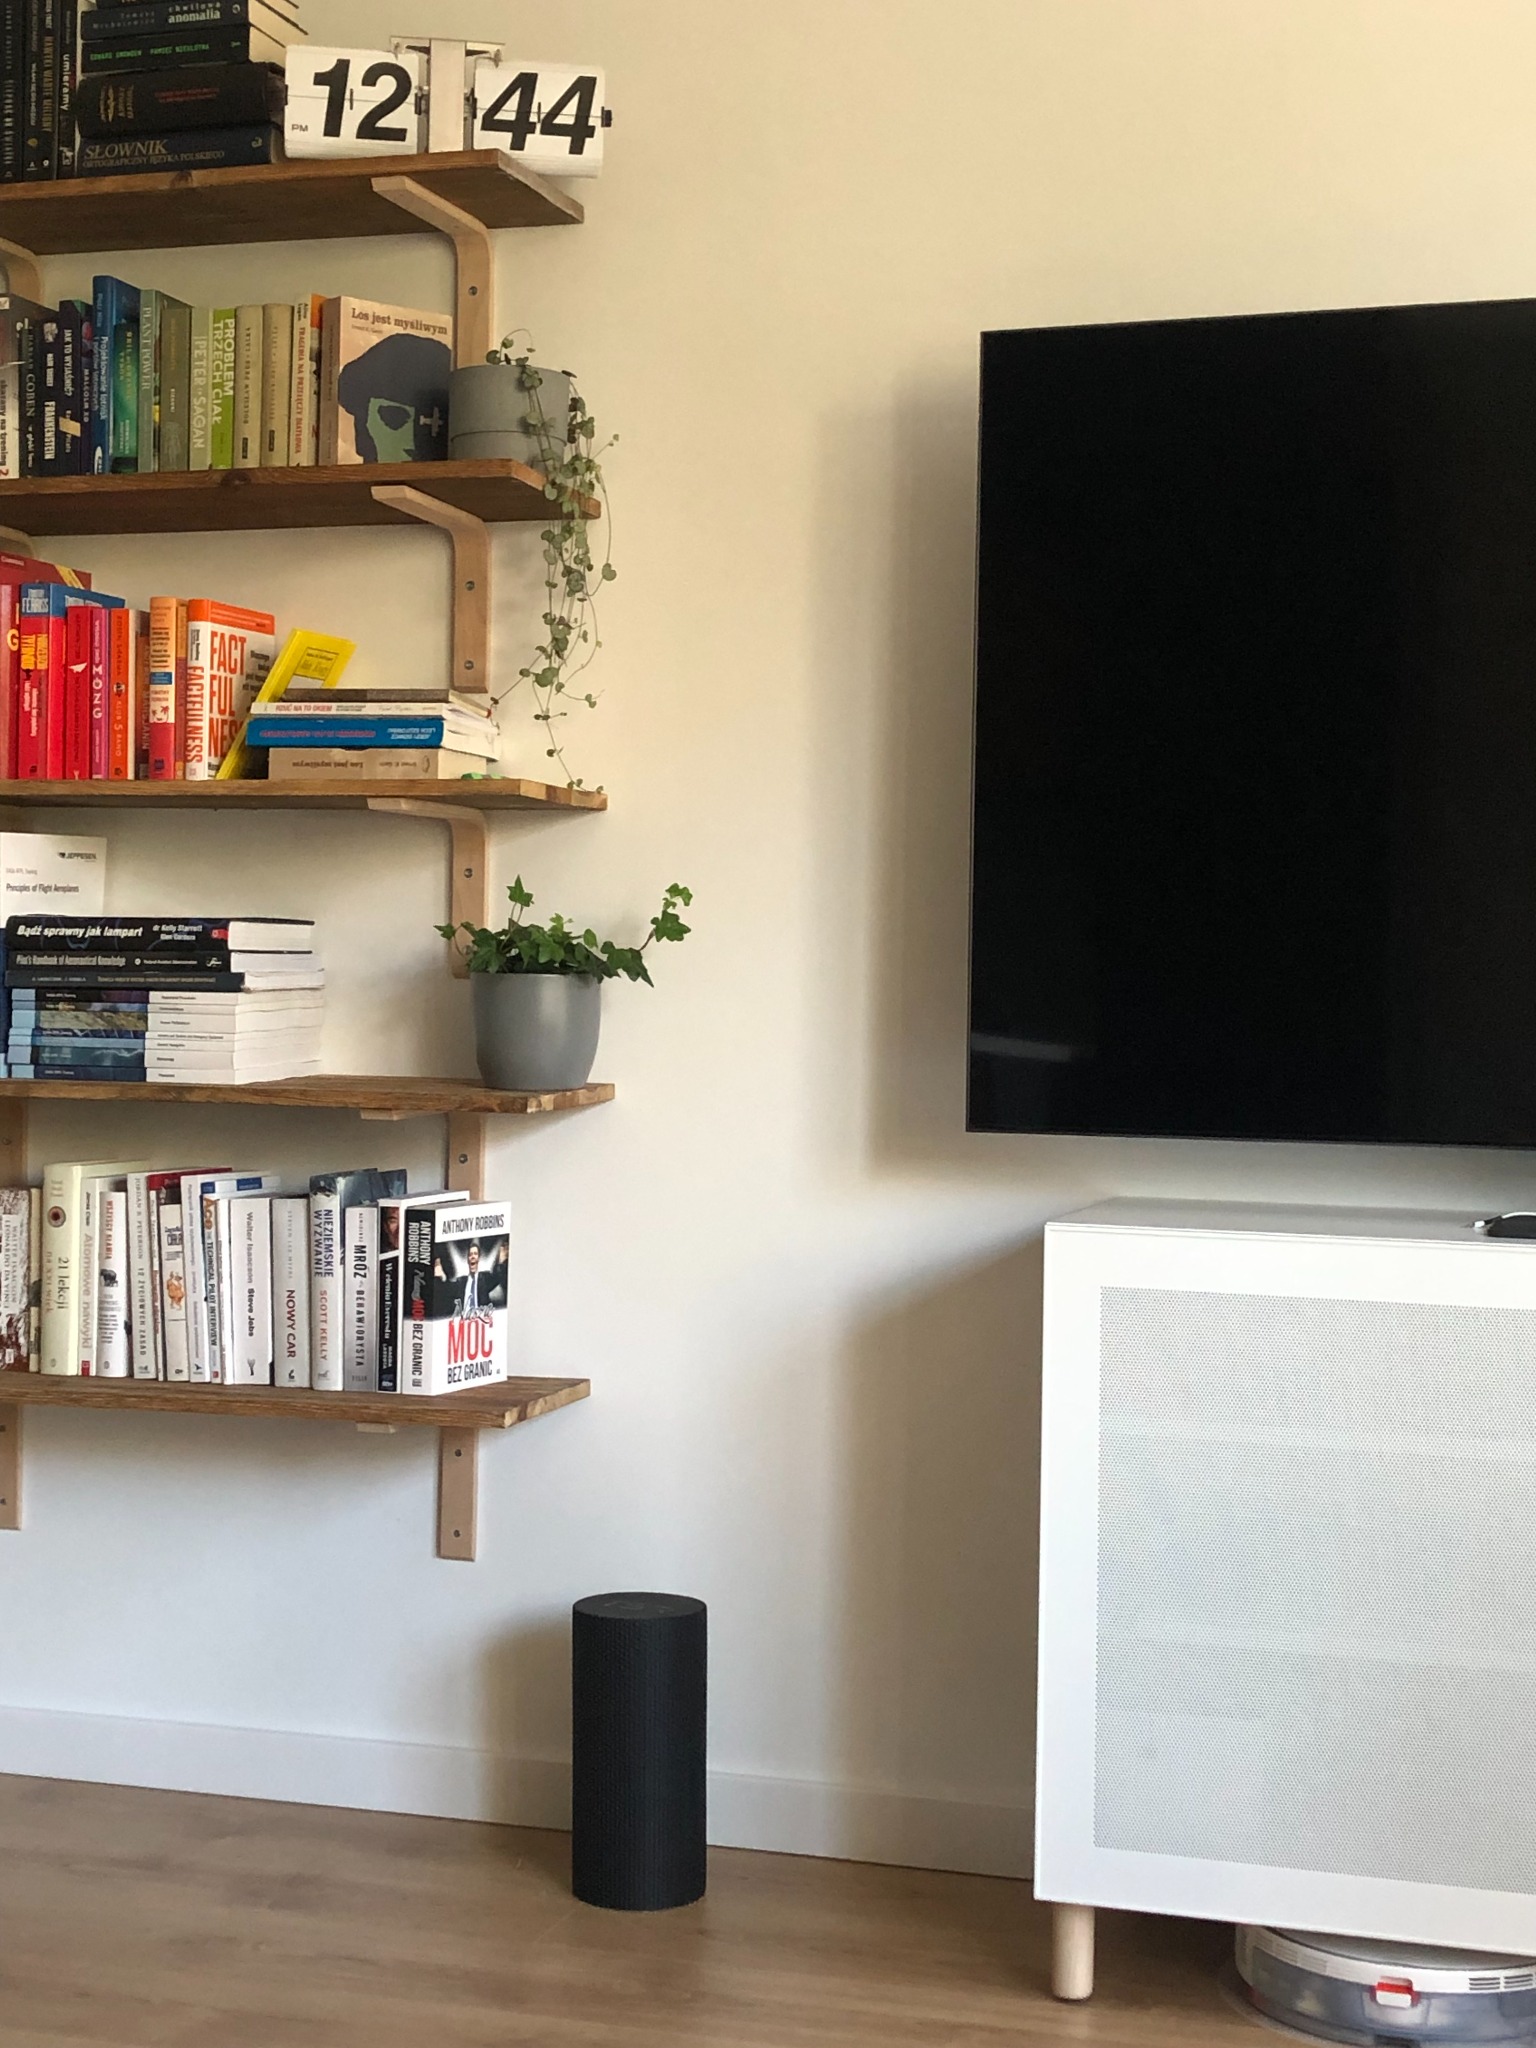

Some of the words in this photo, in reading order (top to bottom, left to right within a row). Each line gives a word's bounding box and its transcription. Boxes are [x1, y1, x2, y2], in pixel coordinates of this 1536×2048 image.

[168, 9, 221, 23] anomalia
[60, 54, 72, 111] umieramy
[313, 58, 412, 142] 12
[480, 72, 597, 155] 44
[291, 124, 309, 133] PM
[84, 139, 169, 159] SŁOWNIK
[180, 151, 225, 162] POLSKIEGO
[142, 307, 152, 345] PLANT
[352, 308, 369, 321] Los
[371, 312, 391, 326] jest
[63, 343, 72, 353] TO
[64, 329, 72, 342] JAK
[212, 320, 224, 382] TRZECH
[297, 327, 306, 362] TRAGEDIA
[99, 336, 109, 392] Projektowanie
[142, 348, 152, 390] POWER
[194, 340, 207, 385] PETER
[223, 318, 235, 396] PROBLEM
[297, 363, 305, 374] NA
[26, 373, 36, 417] COBEN
[99, 393, 108, 420] lotnisk
[211, 389, 223, 425] CIAŁ
[44, 401, 56, 460] FRANKENSTEIN
[193, 396, 206, 448] SAGAN
[210, 630, 247, 676] FACT
[210, 674, 235, 717] FUL
[275, 703, 292, 712] RZUĆ
[293, 704, 302, 712] NA
[186, 666, 205, 764] FACTFULNESS
[208, 717, 244, 758] NES
[333, 760, 348, 768] jest
[6, 884, 30, 894] Principles
[32, 884, 38, 892] of
[39, 884, 53, 895] Flight
[16, 924, 42, 938] Bądź
[43, 927, 85, 938] sprawny
[84, 926, 102, 938] jak
[103, 926, 143, 938] lampart
[161, 924, 177, 933] Kelly
[105, 1200, 113, 1232] WSZYSCY
[203, 1197, 216, 1230] Ace
[246, 1212, 254, 1241] Walter
[442, 1218, 474, 1235] ANTHONY
[475, 1214, 504, 1230] ROBBINS
[45, 1251, 53, 1264] na
[313, 1210, 323, 1278] WYZWANIE
[323, 1209, 334, 1278] NIEZIEMSKIE
[408, 1222, 419, 1262] ROBBINS
[419, 1221, 431, 1265] ANTHONY
[4, 1269, 10, 1281] DA
[57, 1257, 69, 1270] 21
[82, 1233, 93, 1296] Atomowe
[137, 1267, 145, 1276] 12
[206, 1241, 215, 1281] TECHNICAL
[245, 1243, 254, 1284] Isaacson
[354, 1245, 370, 1279] MRÓZ
[45, 1290, 54, 1313] wiek
[55, 1275, 70, 1309] lekcji
[138, 1280, 146, 1326] ŻYCIOWYCH
[207, 1283, 216, 1304] PILOT
[247, 1287, 255, 1313] Steve
[319, 1289, 327, 1324] SCOTT
[81, 1301, 93, 1349] nawyki
[209, 1305, 218, 1347] INTERVIEW
[248, 1315, 256, 1337] Jobs
[286, 1289, 296, 1331] NOWY
[411, 1299, 424, 1322] MOC
[139, 1329, 147, 1356] ZASAD
[286, 1332, 296, 1358] CAR
[320, 1327, 328, 1361] KELLY
[355, 1290, 365, 1367] BEHAWIORYSTA
[412, 1323, 423, 1340] BEZ
[448, 1317, 493, 1365] MOC
[411, 1342, 423, 1376] GRANIC
[447, 1365, 462, 1384] BEZ
[464, 1360, 493, 1380] GRANIC
